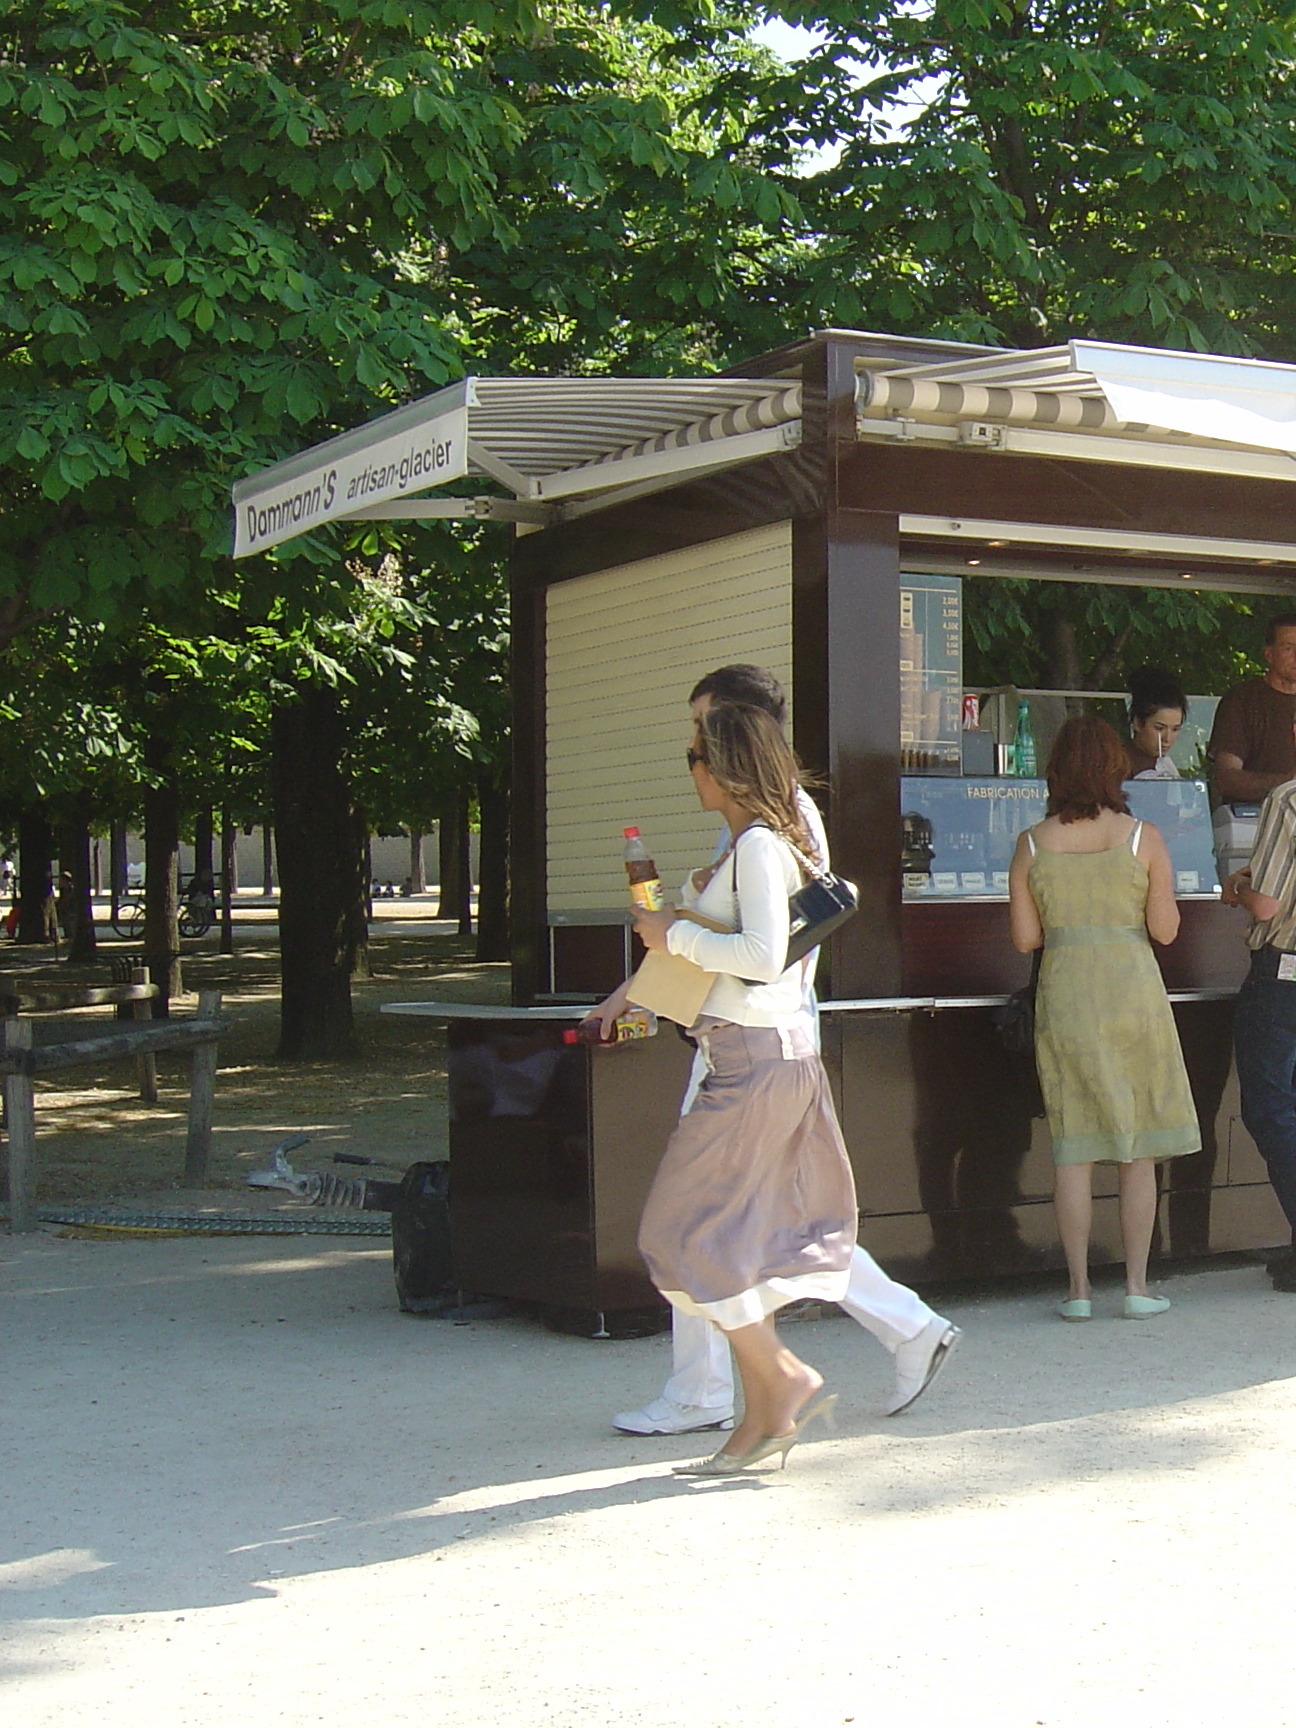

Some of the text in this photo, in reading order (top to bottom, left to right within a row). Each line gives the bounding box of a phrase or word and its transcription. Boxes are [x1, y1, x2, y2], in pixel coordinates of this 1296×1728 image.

[247, 438, 452, 543] Dammann'S artisan-glacier
[968, 787, 1039, 799] FABRICATION
